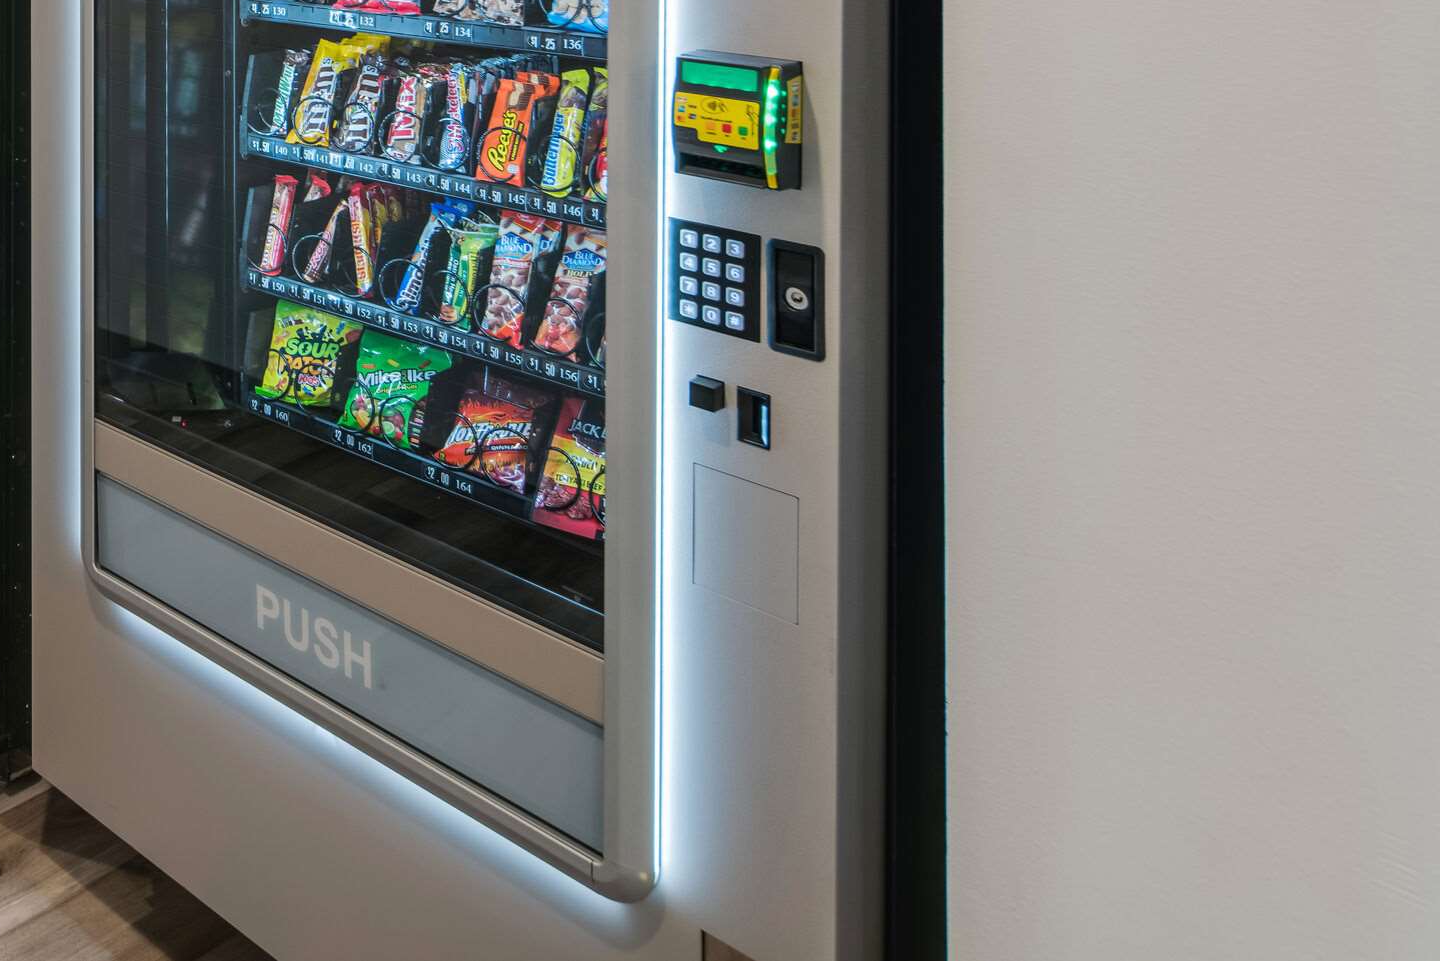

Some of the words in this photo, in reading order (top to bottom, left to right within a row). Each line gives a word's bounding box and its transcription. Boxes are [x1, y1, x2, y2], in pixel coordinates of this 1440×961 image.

[272, 6, 286, 16] 130
[359, 16, 374, 27] 132
[454, 27, 471, 37] 134
[563, 38, 581, 49] 136
[275, 145, 288, 156] 140
[316, 153, 329, 164] 141
[359, 162, 374, 173] 142
[406, 171, 421, 182] 143
[455, 182, 470, 193] 144
[508, 192, 525, 204] 145
[563, 204, 581, 216] 146
[501, 235, 521, 246] BLUE
[684, 234, 694, 245] 1
[706, 239, 716, 250] 2
[730, 244, 739, 254] 3
[562, 255, 602, 266] DIAMOND
[575, 251, 595, 261] BLUE
[685, 257, 694, 268] 4
[707, 262, 716, 273] 5
[730, 267, 740, 278] 6
[272, 281, 285, 293] 150
[685, 281, 694, 291] 7
[707, 286, 716, 297] 8
[730, 291, 739, 302] 9
[313, 293, 326, 305] 151
[357, 306, 371, 318] 152
[707, 310, 716, 320] 0
[403, 321, 418, 333] 153
[451, 335, 466, 348] 154
[286, 338, 340, 360] SOUR
[505, 351, 522, 365] 155
[280, 355, 337, 376] PATCH
[358, 370, 402, 389] Mike
[407, 369, 436, 382] Ike
[560, 368, 577, 382] 156
[275, 410, 288, 423] 160
[568, 420, 601, 439] JACK
[358, 441, 372, 455] 162
[456, 479, 471, 494] 164
[256, 583, 372, 689] PUSH
